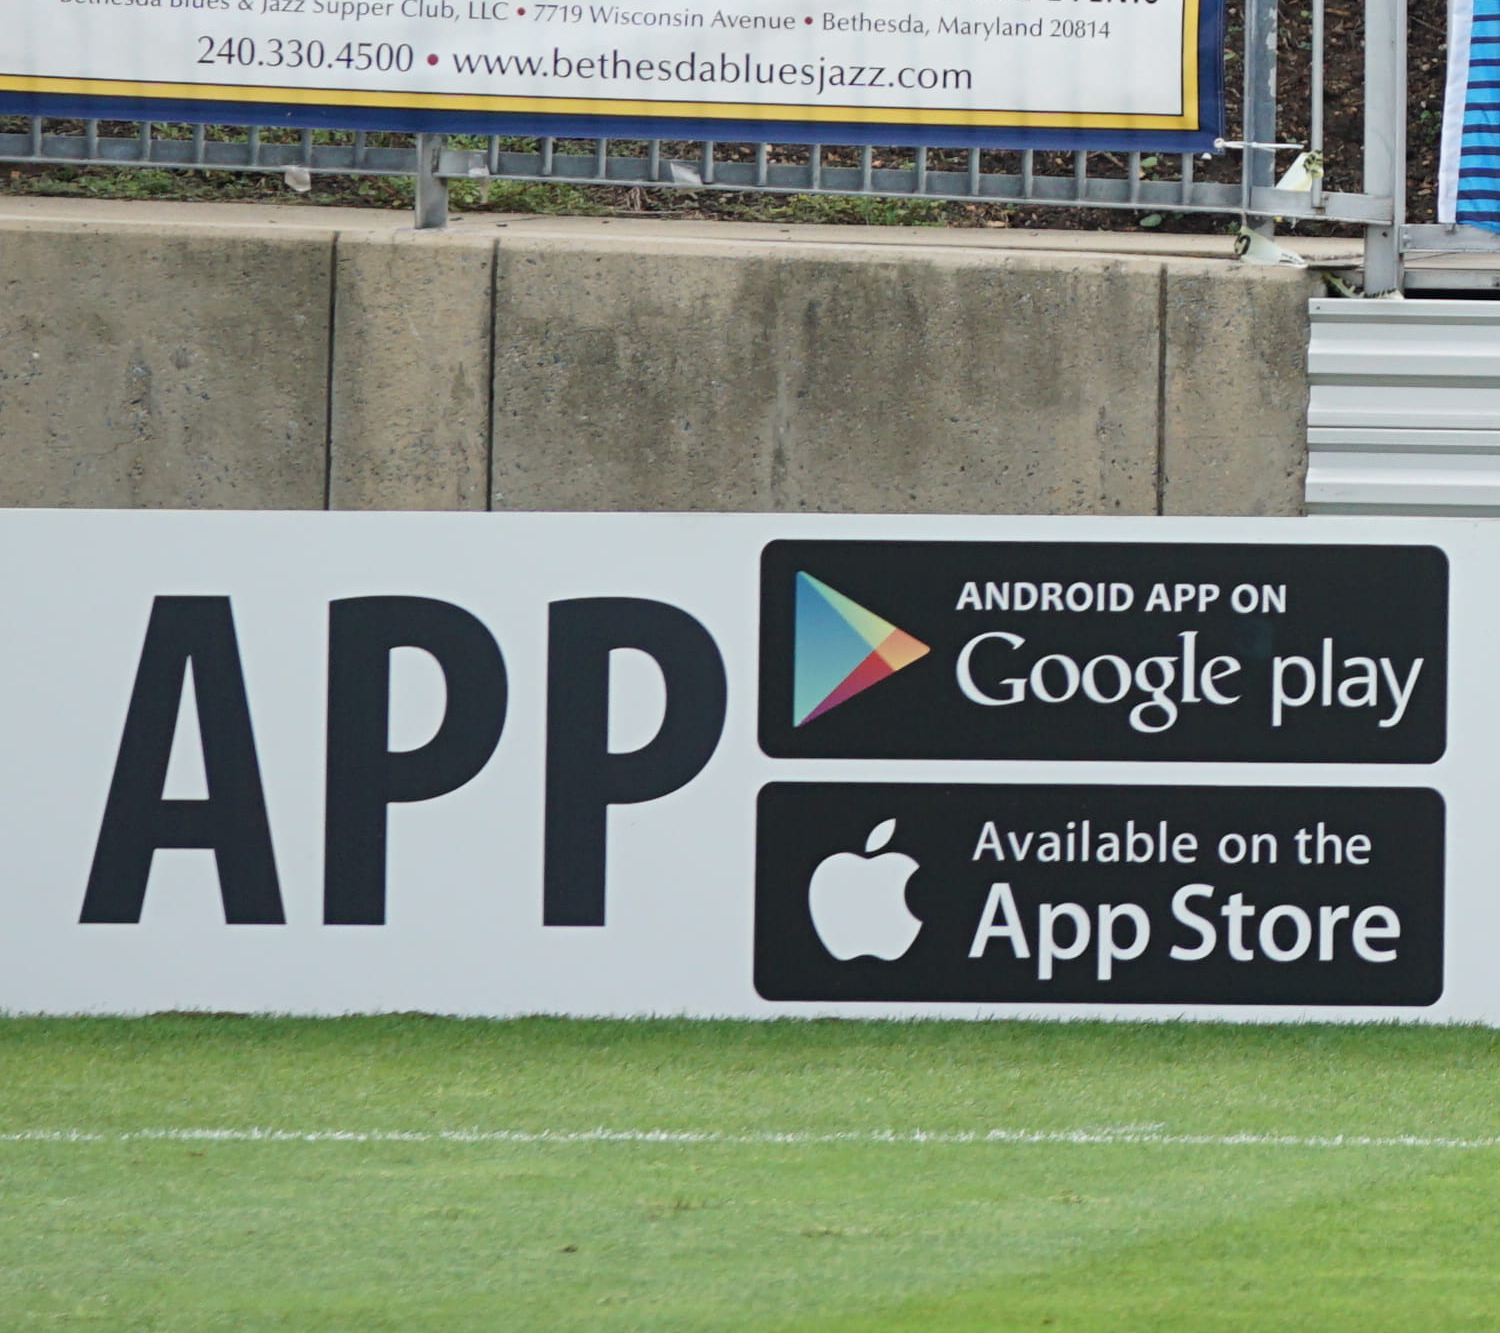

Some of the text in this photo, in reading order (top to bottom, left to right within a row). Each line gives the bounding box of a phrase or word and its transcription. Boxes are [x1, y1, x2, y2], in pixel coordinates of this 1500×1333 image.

[468, 0, 510, 22] LLC
[534, 4, 583, 24] 7719
[590, 4, 703, 28] Wisconsin
[710, 10, 797, 30] Avenue
[822, 11, 930, 37] Bethesda,
[938, 13, 1043, 42] Maryland
[1049, 18, 1112, 40] 20814
[197, 35, 973, 95] 240.330.4500 www.bethesdabluesjazz.com
[955, 580, 1288, 615] ANDROID APP ON
[956, 630, 1424, 734] Google play
[77, 593, 729, 928] APP
[972, 819, 1372, 865] Available on the
[968, 881, 1401, 981] App Store
